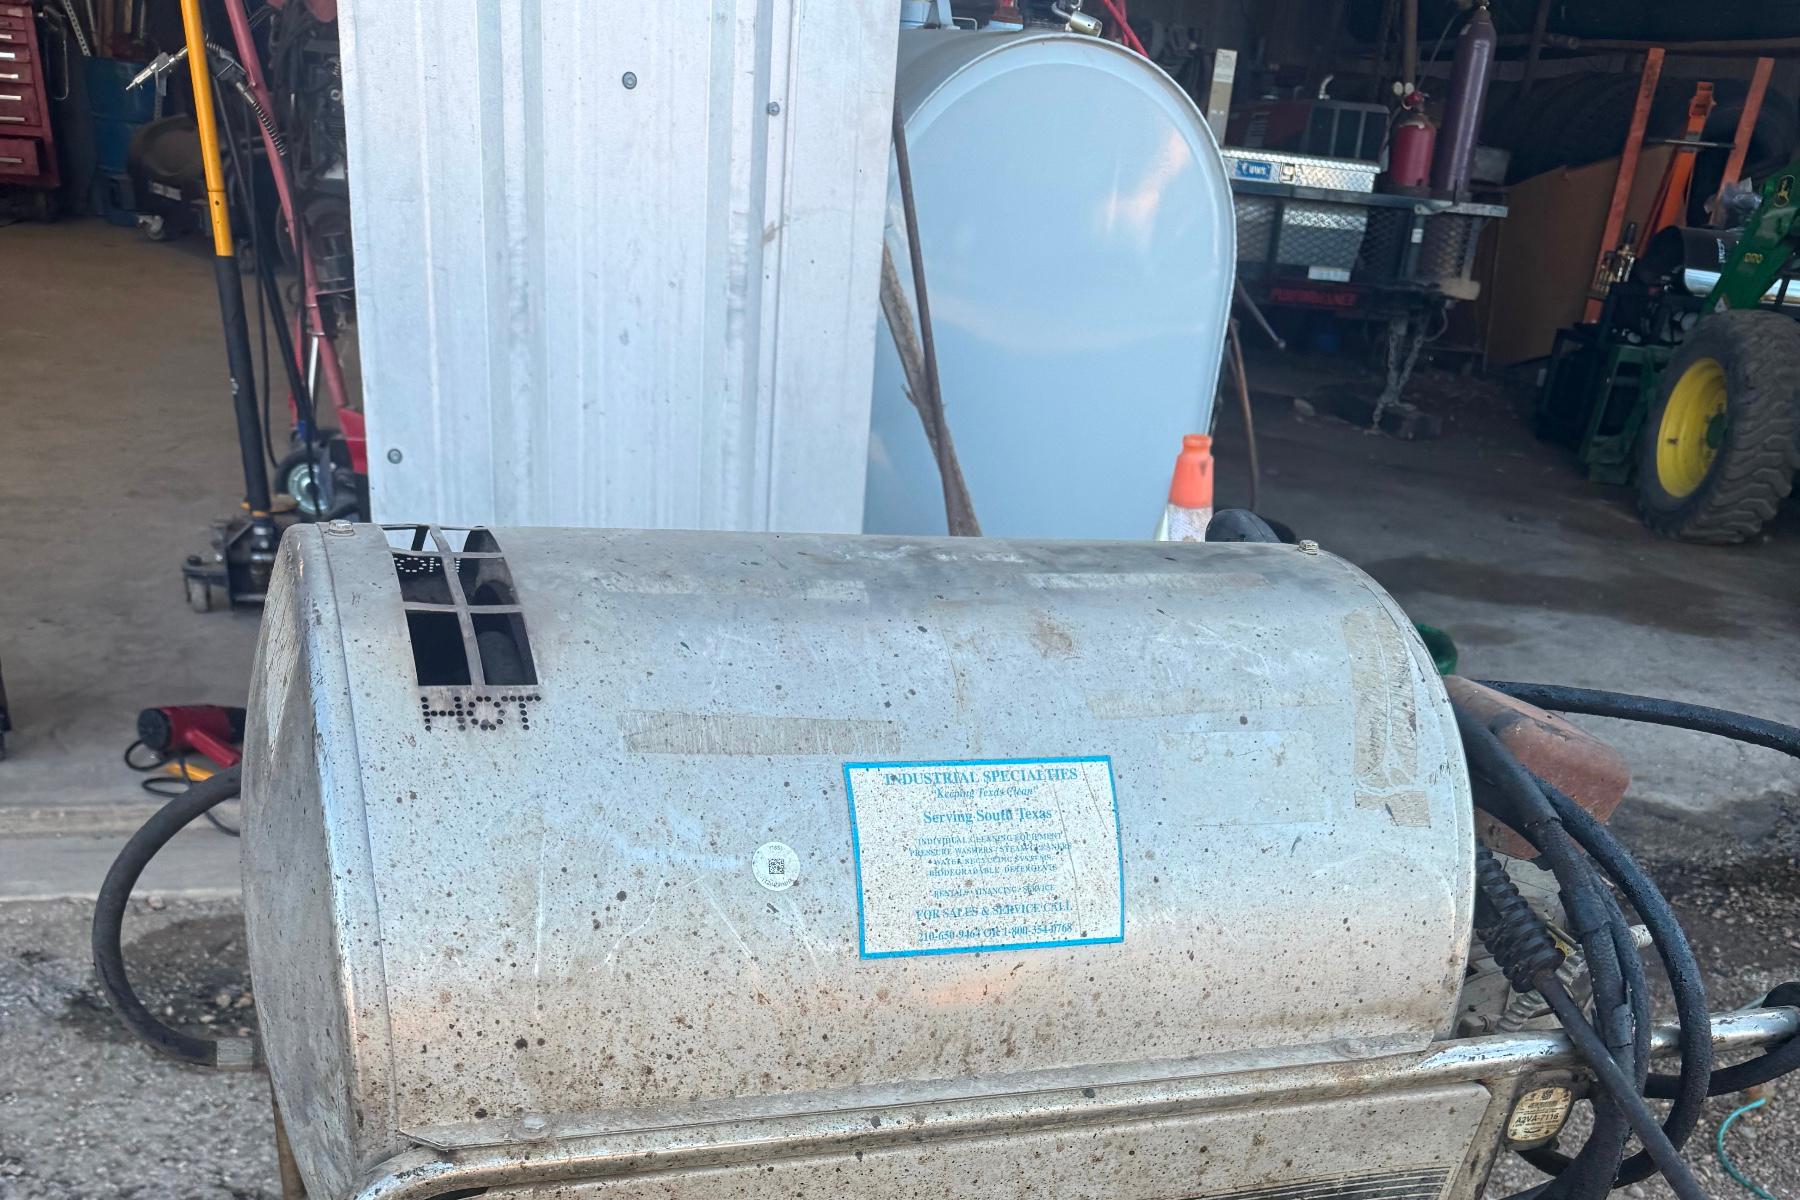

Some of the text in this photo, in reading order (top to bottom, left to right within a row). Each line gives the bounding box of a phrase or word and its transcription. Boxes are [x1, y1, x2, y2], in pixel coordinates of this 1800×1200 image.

[420, 695, 542, 731] HOT
[884, 767, 1078, 786] INDUSTRIAL SPECIALTIES
[923, 806, 1052, 824] Serving South Texas
[916, 909, 940, 921] FOR
[943, 906, 978, 918] SALES
[992, 902, 1040, 915] SERVICE
[1043, 899, 1072, 912] CALL
[983, 927, 1000, 938] OR
